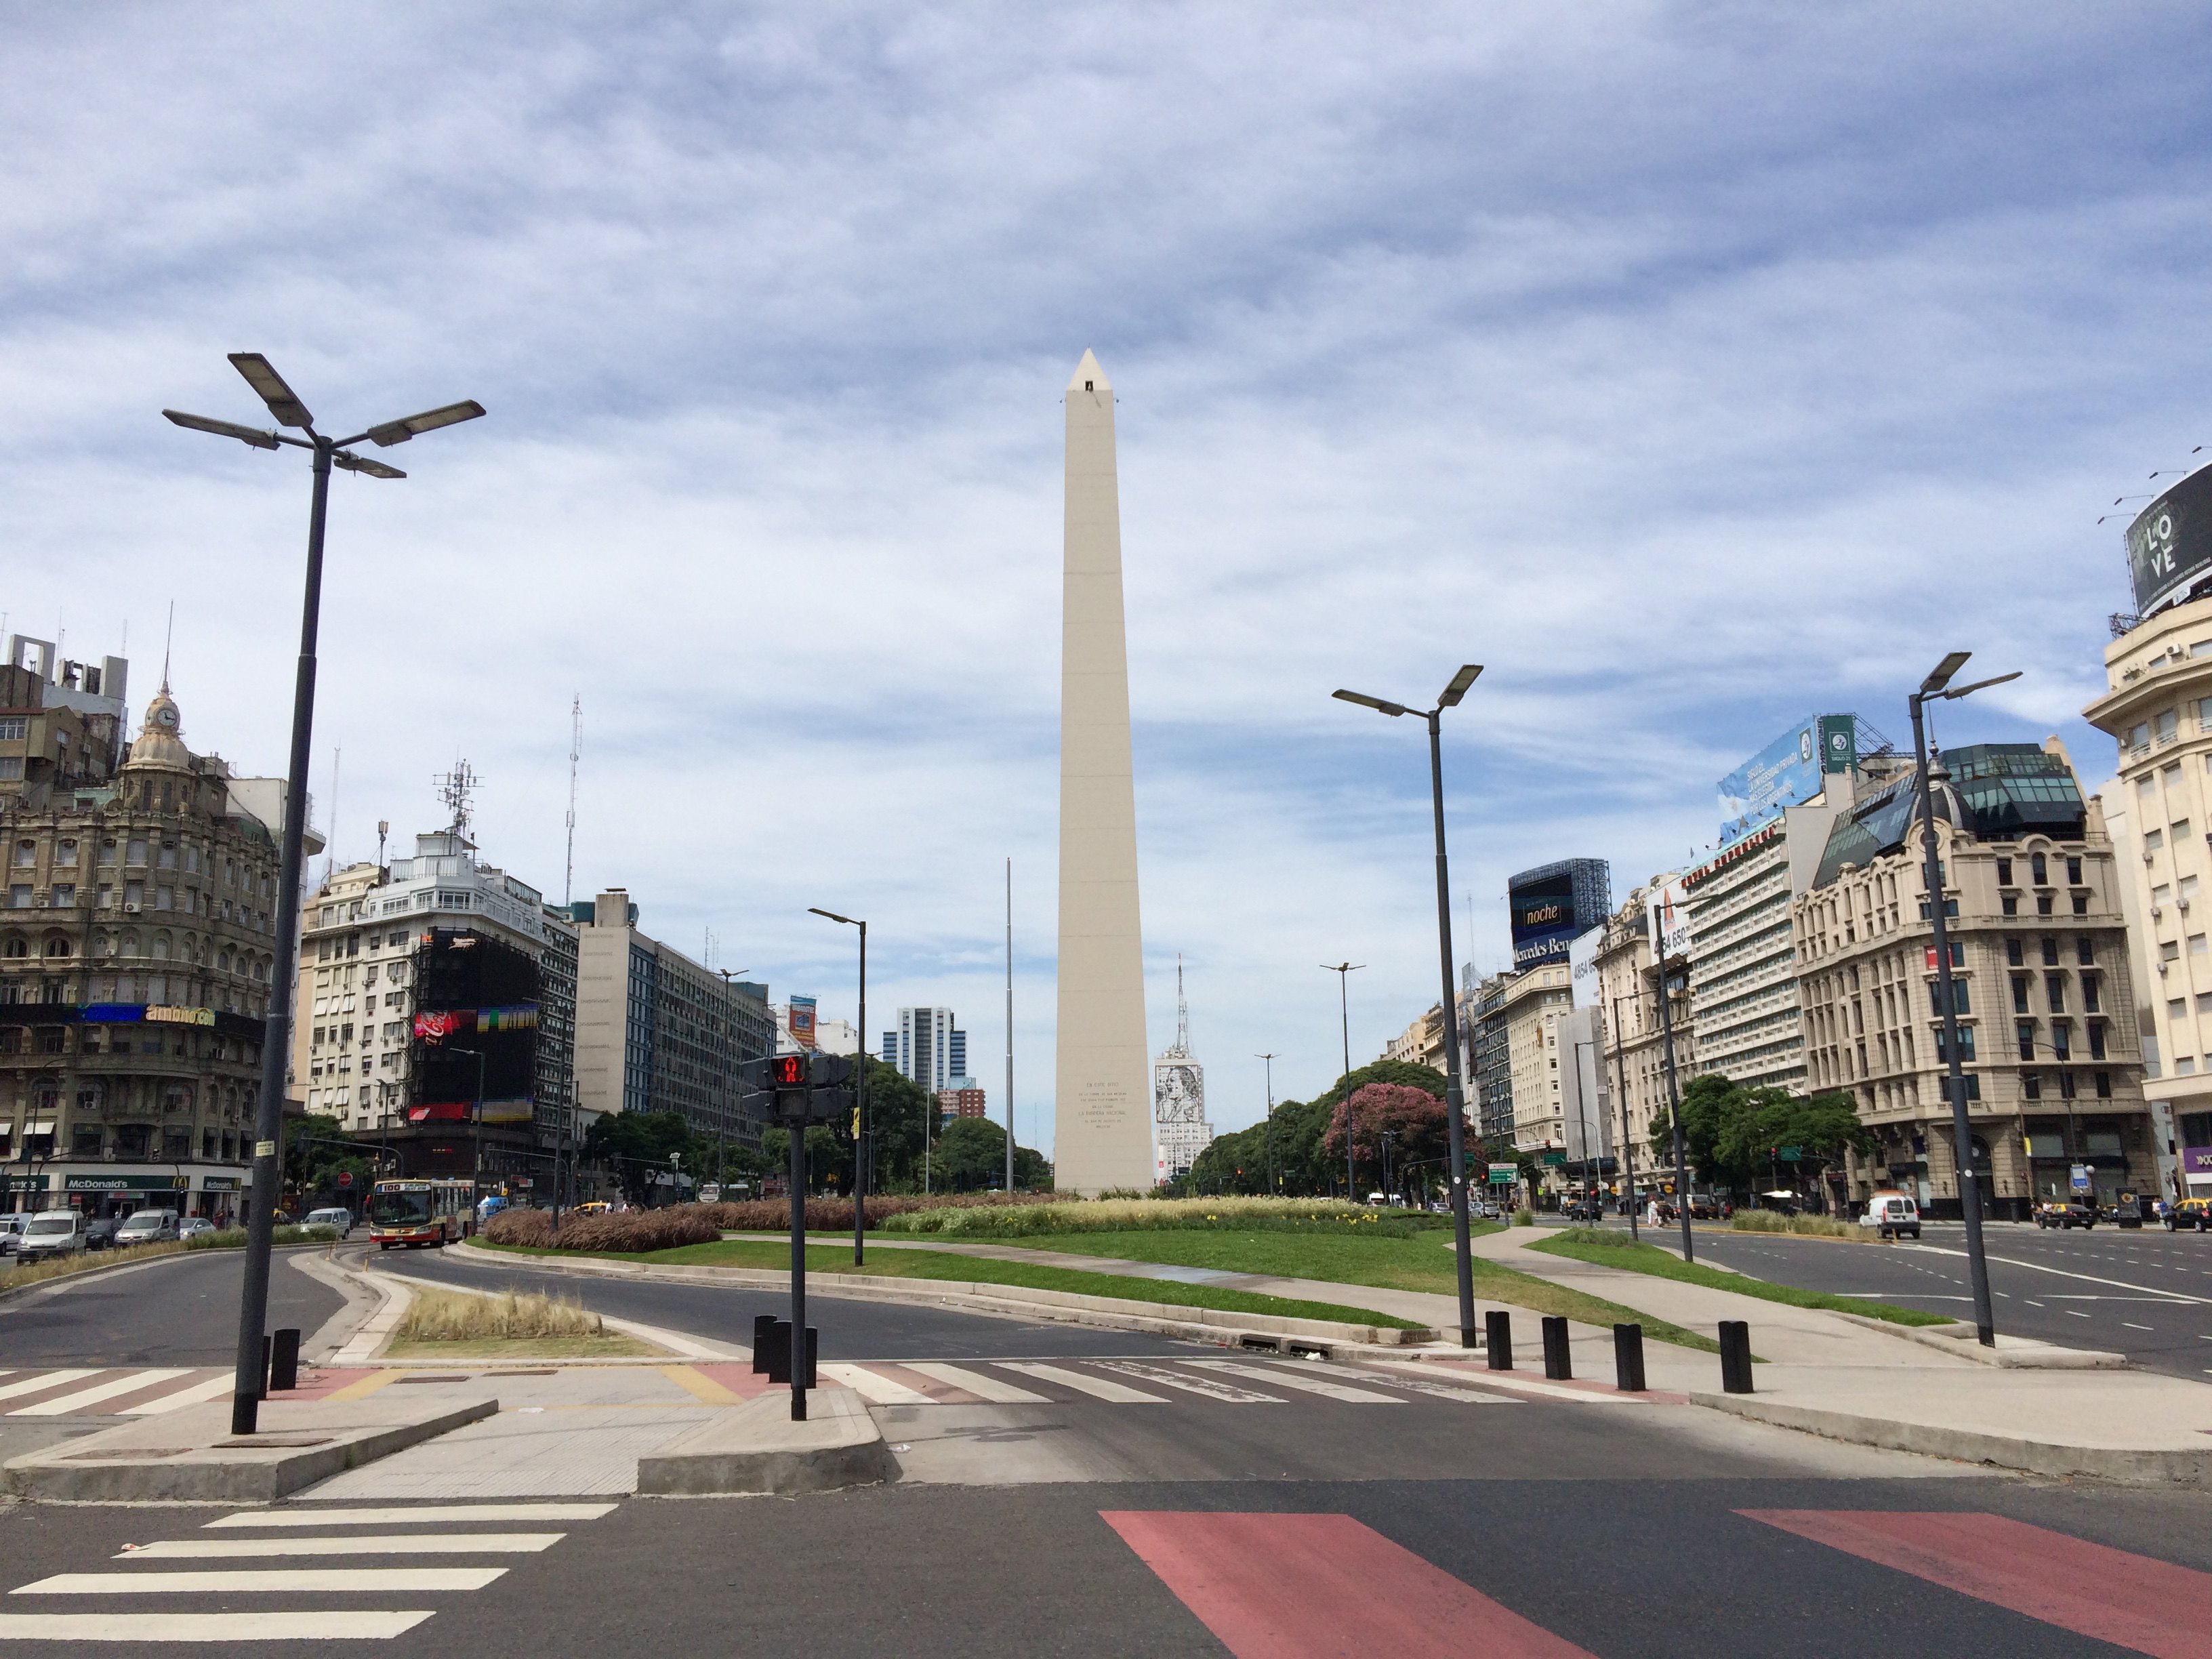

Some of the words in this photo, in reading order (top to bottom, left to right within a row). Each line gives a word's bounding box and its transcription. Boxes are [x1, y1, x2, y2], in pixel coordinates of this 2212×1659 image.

[1527, 903, 1558, 925] noche
[1654, 934, 1671, 957] 454
[1672, 926, 1687, 949] 650
[68, 1180, 128, 1189] McDonald's
[206, 1181, 232, 1190] McDonald's
